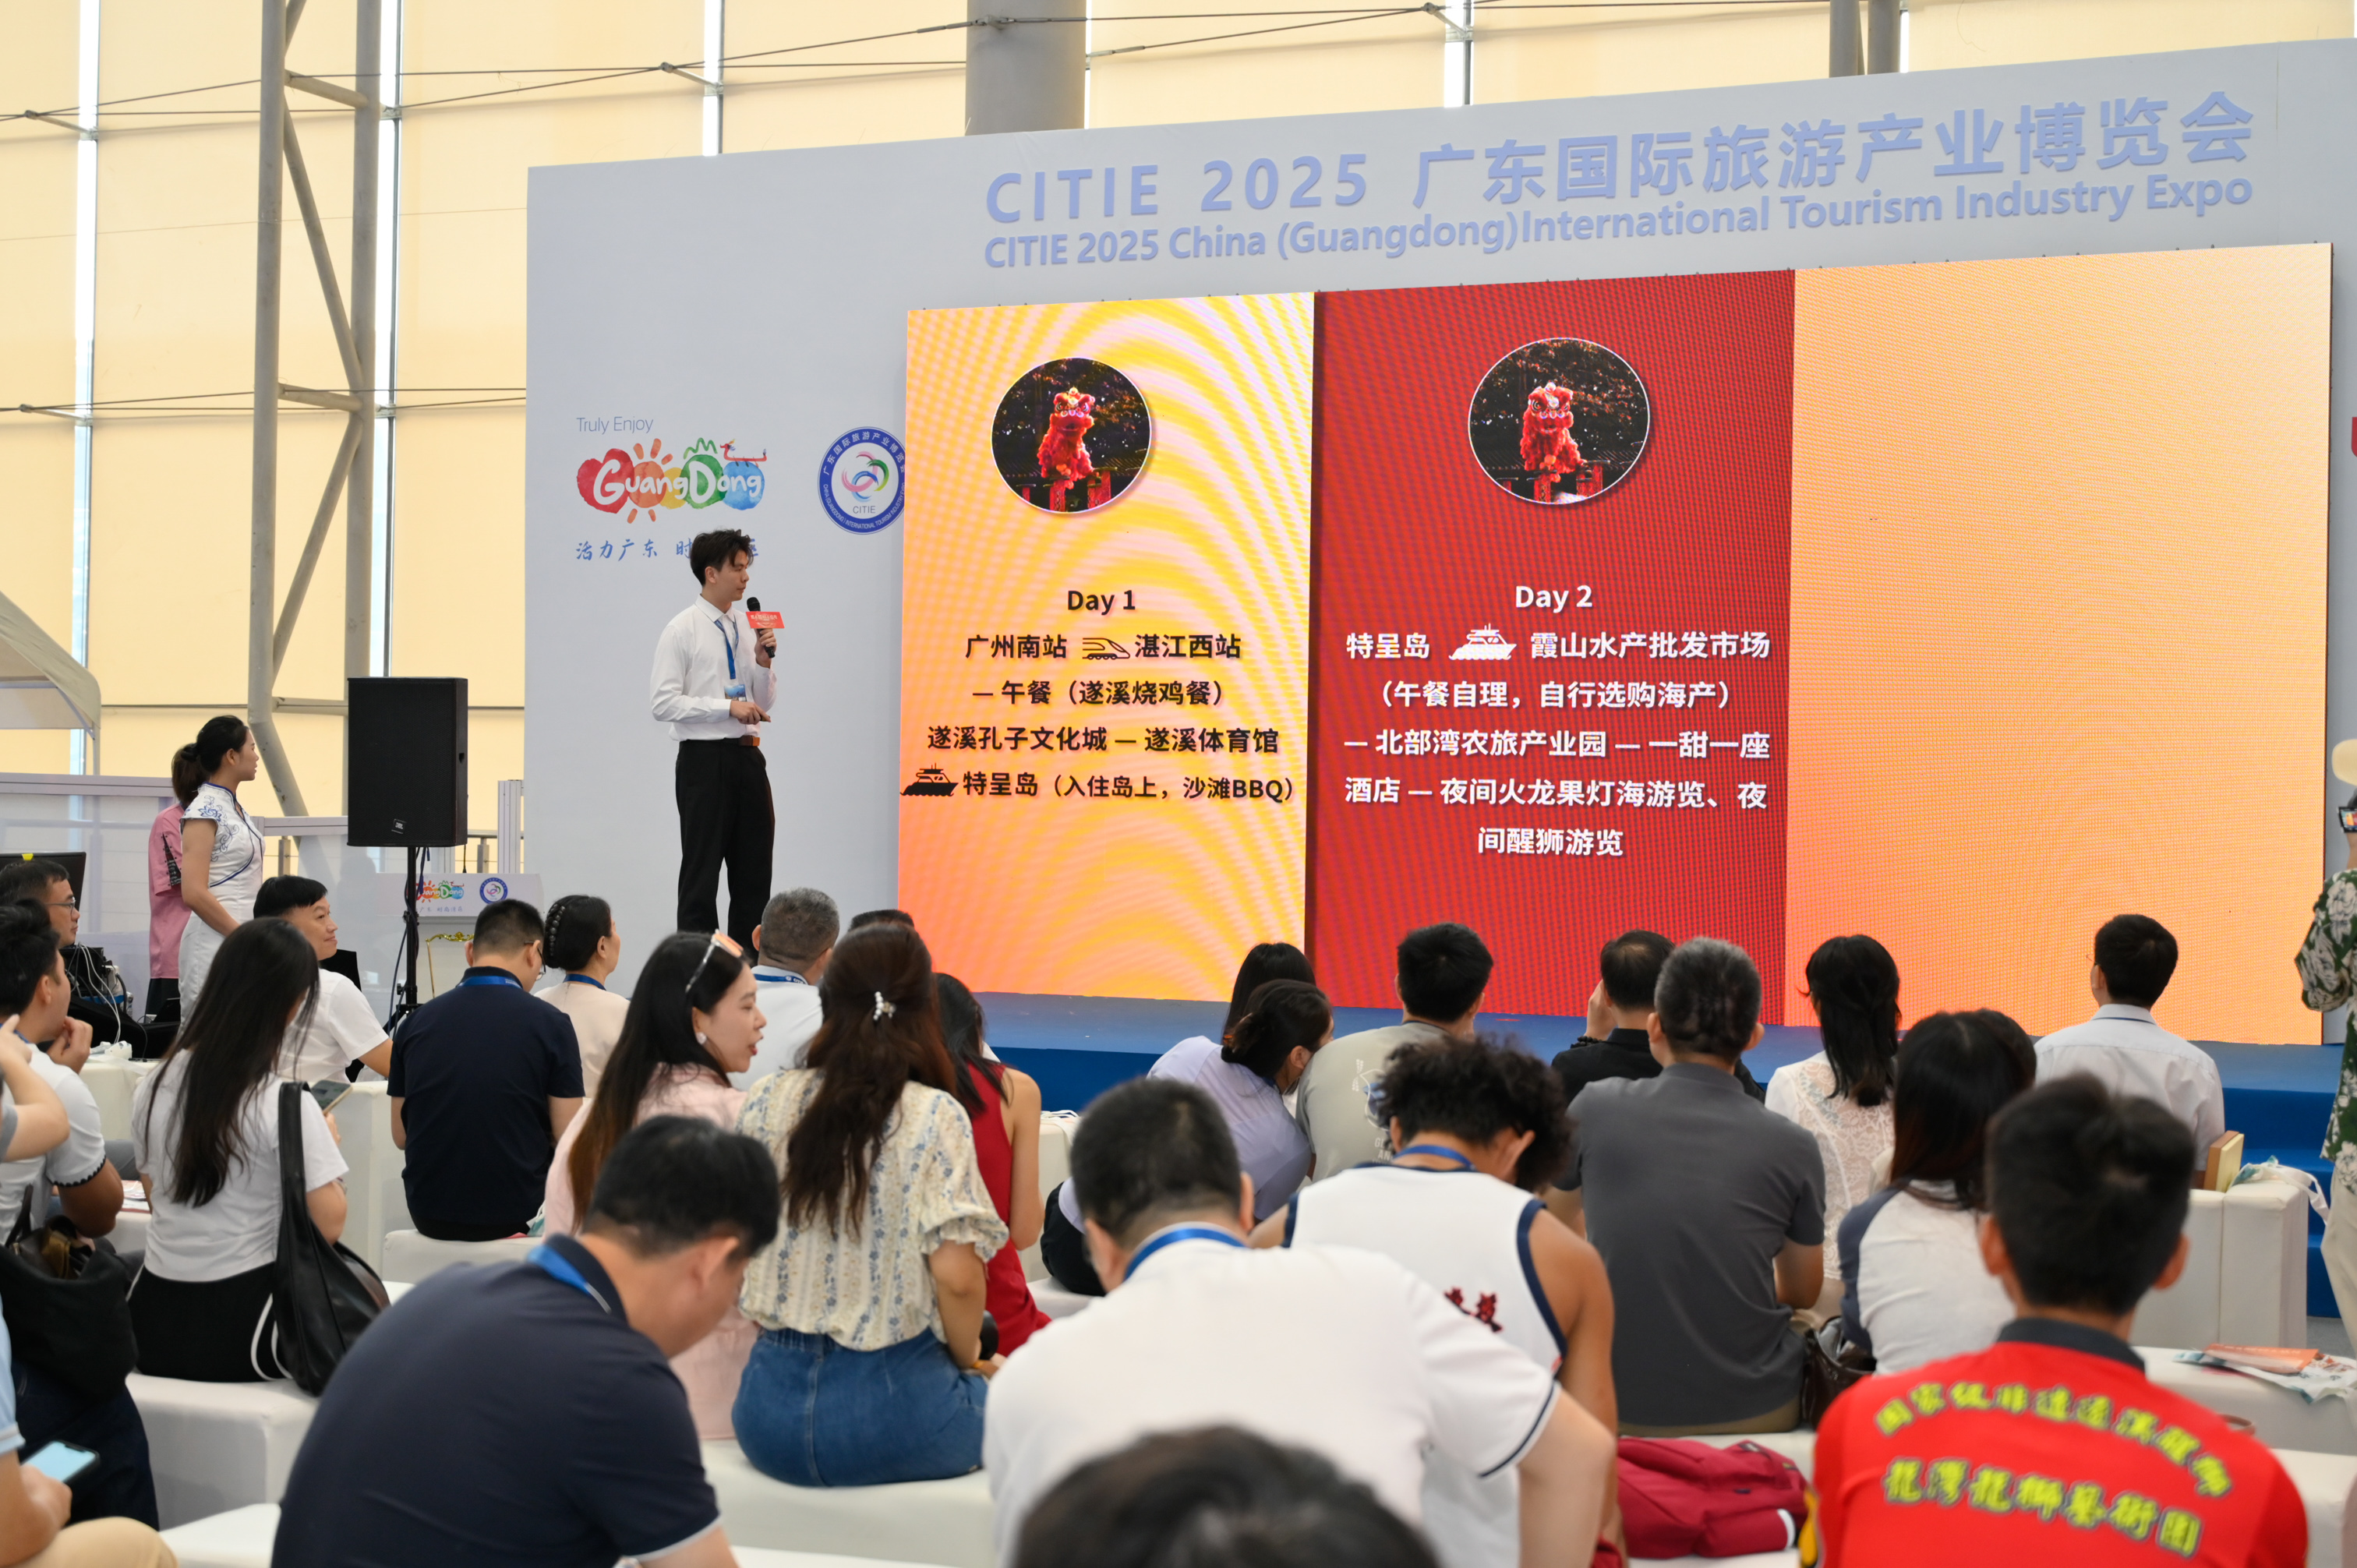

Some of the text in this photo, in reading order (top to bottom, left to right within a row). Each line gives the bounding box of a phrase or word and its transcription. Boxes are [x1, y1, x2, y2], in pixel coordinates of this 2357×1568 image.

[986, 90, 2254, 223] CITIE 2025 广东国际旅游产业博览会
[984, 234, 1068, 267] CITIE
[1077, 229, 1159, 263] 2025
[1169, 224, 1266, 259] China
[1780, 189, 1942, 228] Tourism
[1956, 180, 2134, 221] Industry
[2147, 174, 2253, 216] Expo
[576, 416, 654, 435] Truly Enjoy
[593, 458, 762, 505] GuangDong
[853, 505, 876, 514] CITIE
[576, 538, 659, 562] 活力广东
[1068, 590, 1136, 616] Day 1
[1515, 585, 1592, 613] Day 2
[965, 634, 1241, 659] 广州南站 湛江西站
[1346, 630, 1770, 659] 特呈岛 霞山水产批发市场
[1478, 827, 1624, 856] 间醒狮游览
